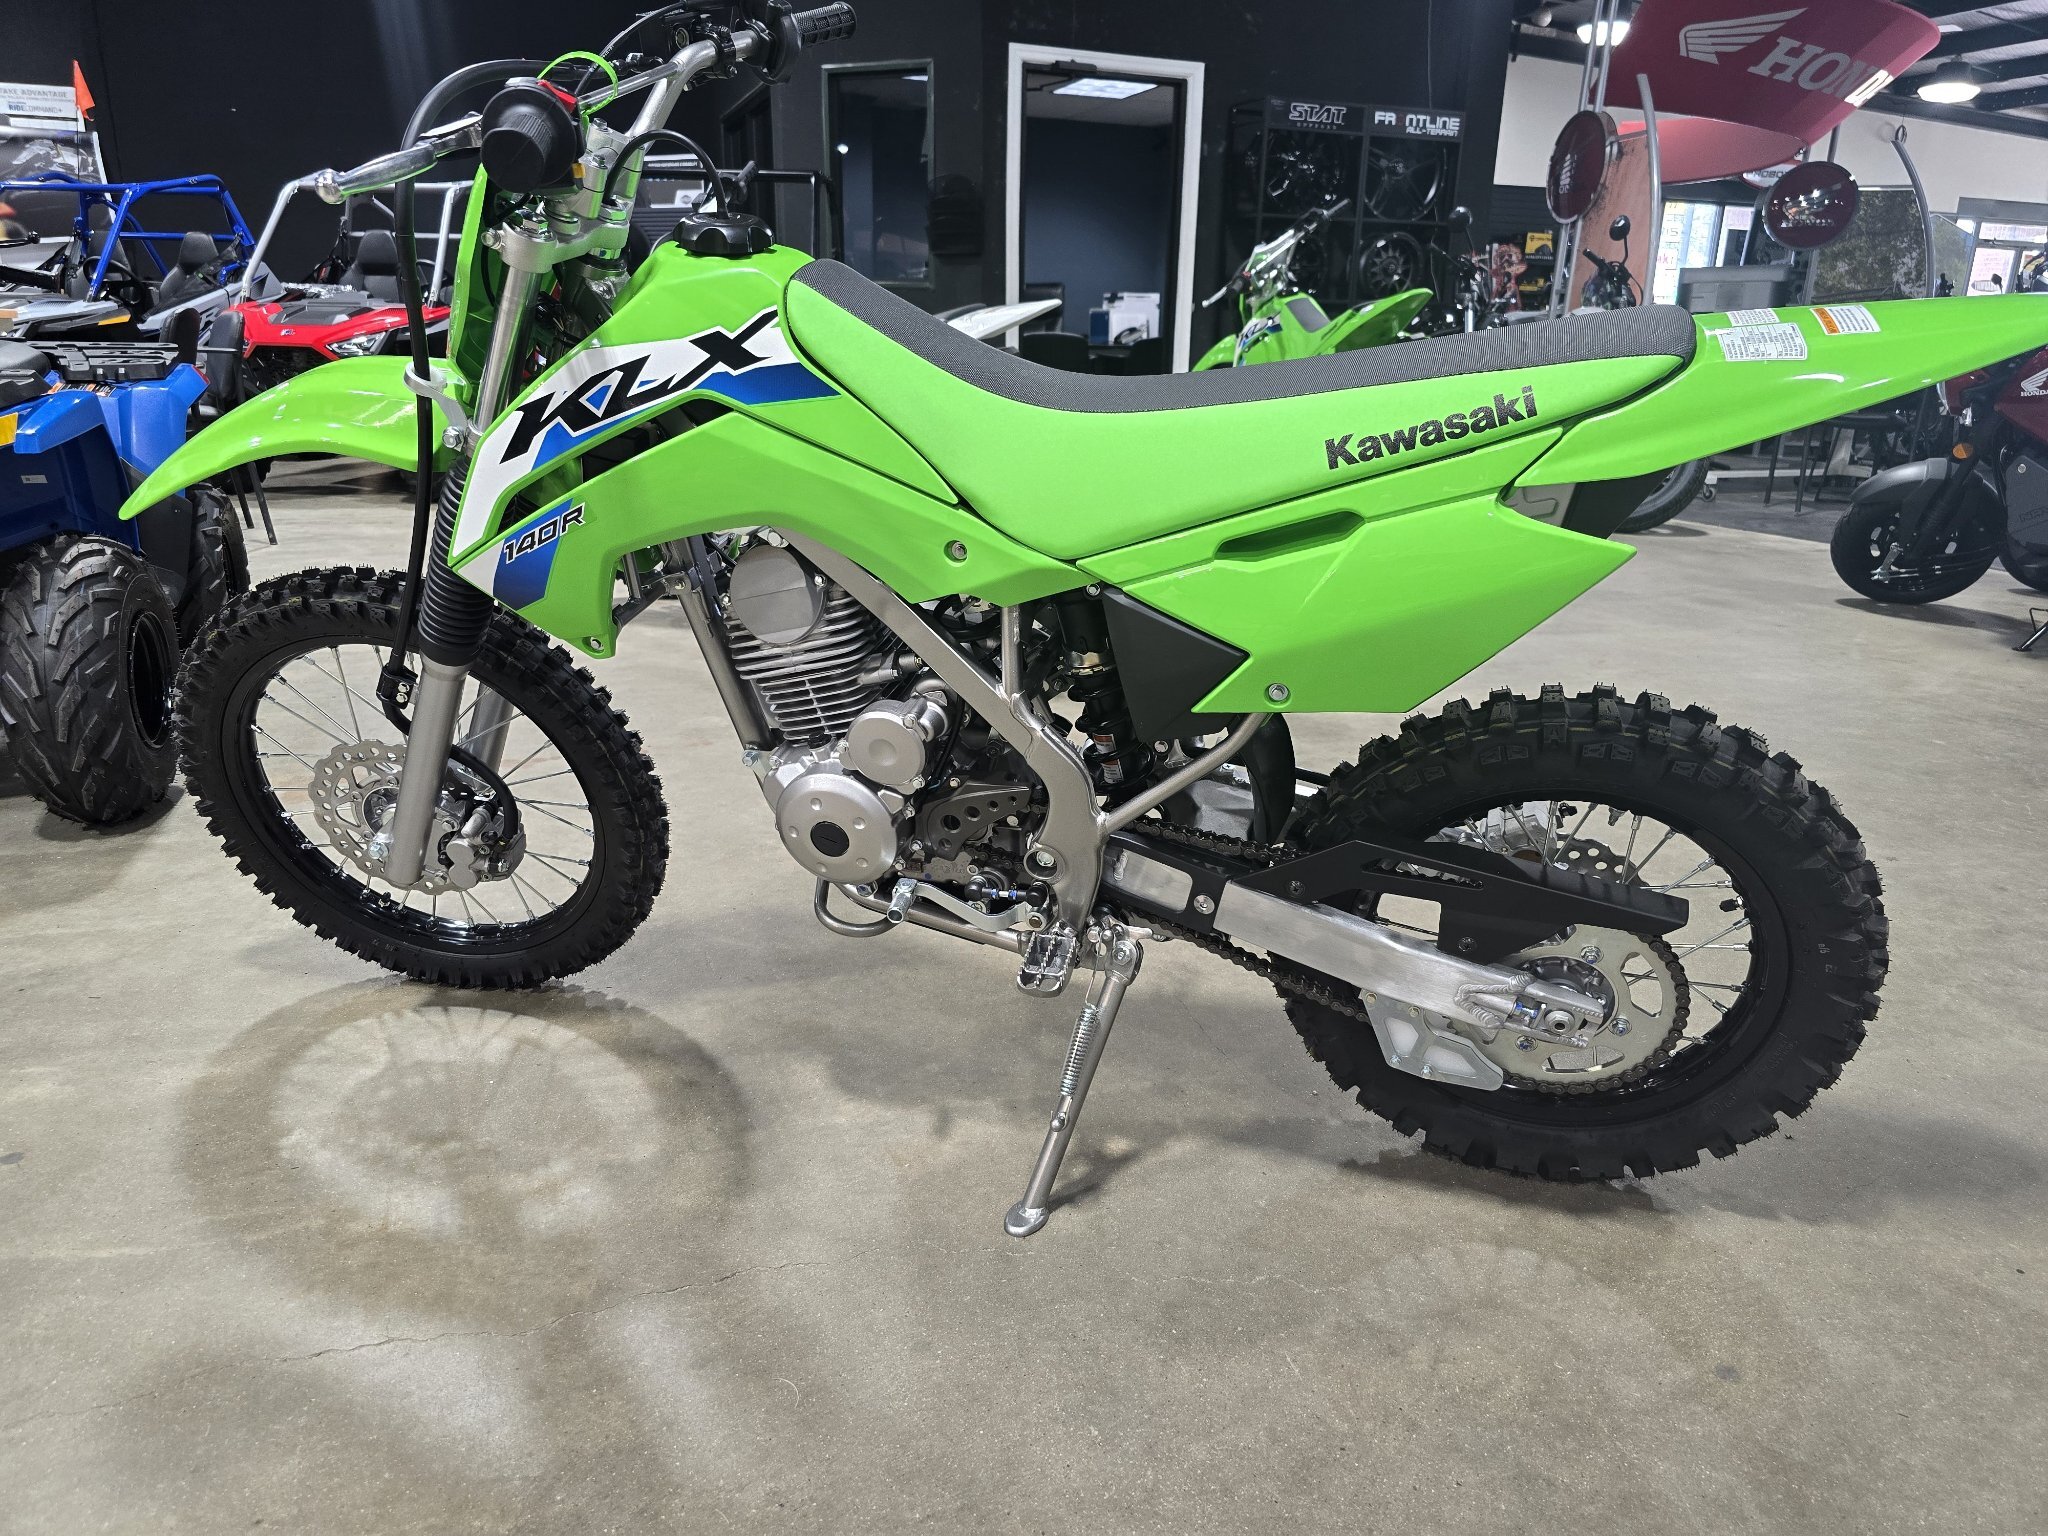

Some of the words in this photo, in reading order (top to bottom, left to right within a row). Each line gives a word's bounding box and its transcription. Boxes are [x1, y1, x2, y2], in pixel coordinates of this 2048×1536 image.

[21, 89, 67, 98] ADVANTAGE
[1289, 102, 1347, 125] STAT
[1406, 126, 1459, 138] ALL-TERRAIN
[499, 308, 778, 465] KLX
[1324, 384, 1539, 471] Kawasaki
[503, 502, 586, 564] 140R
